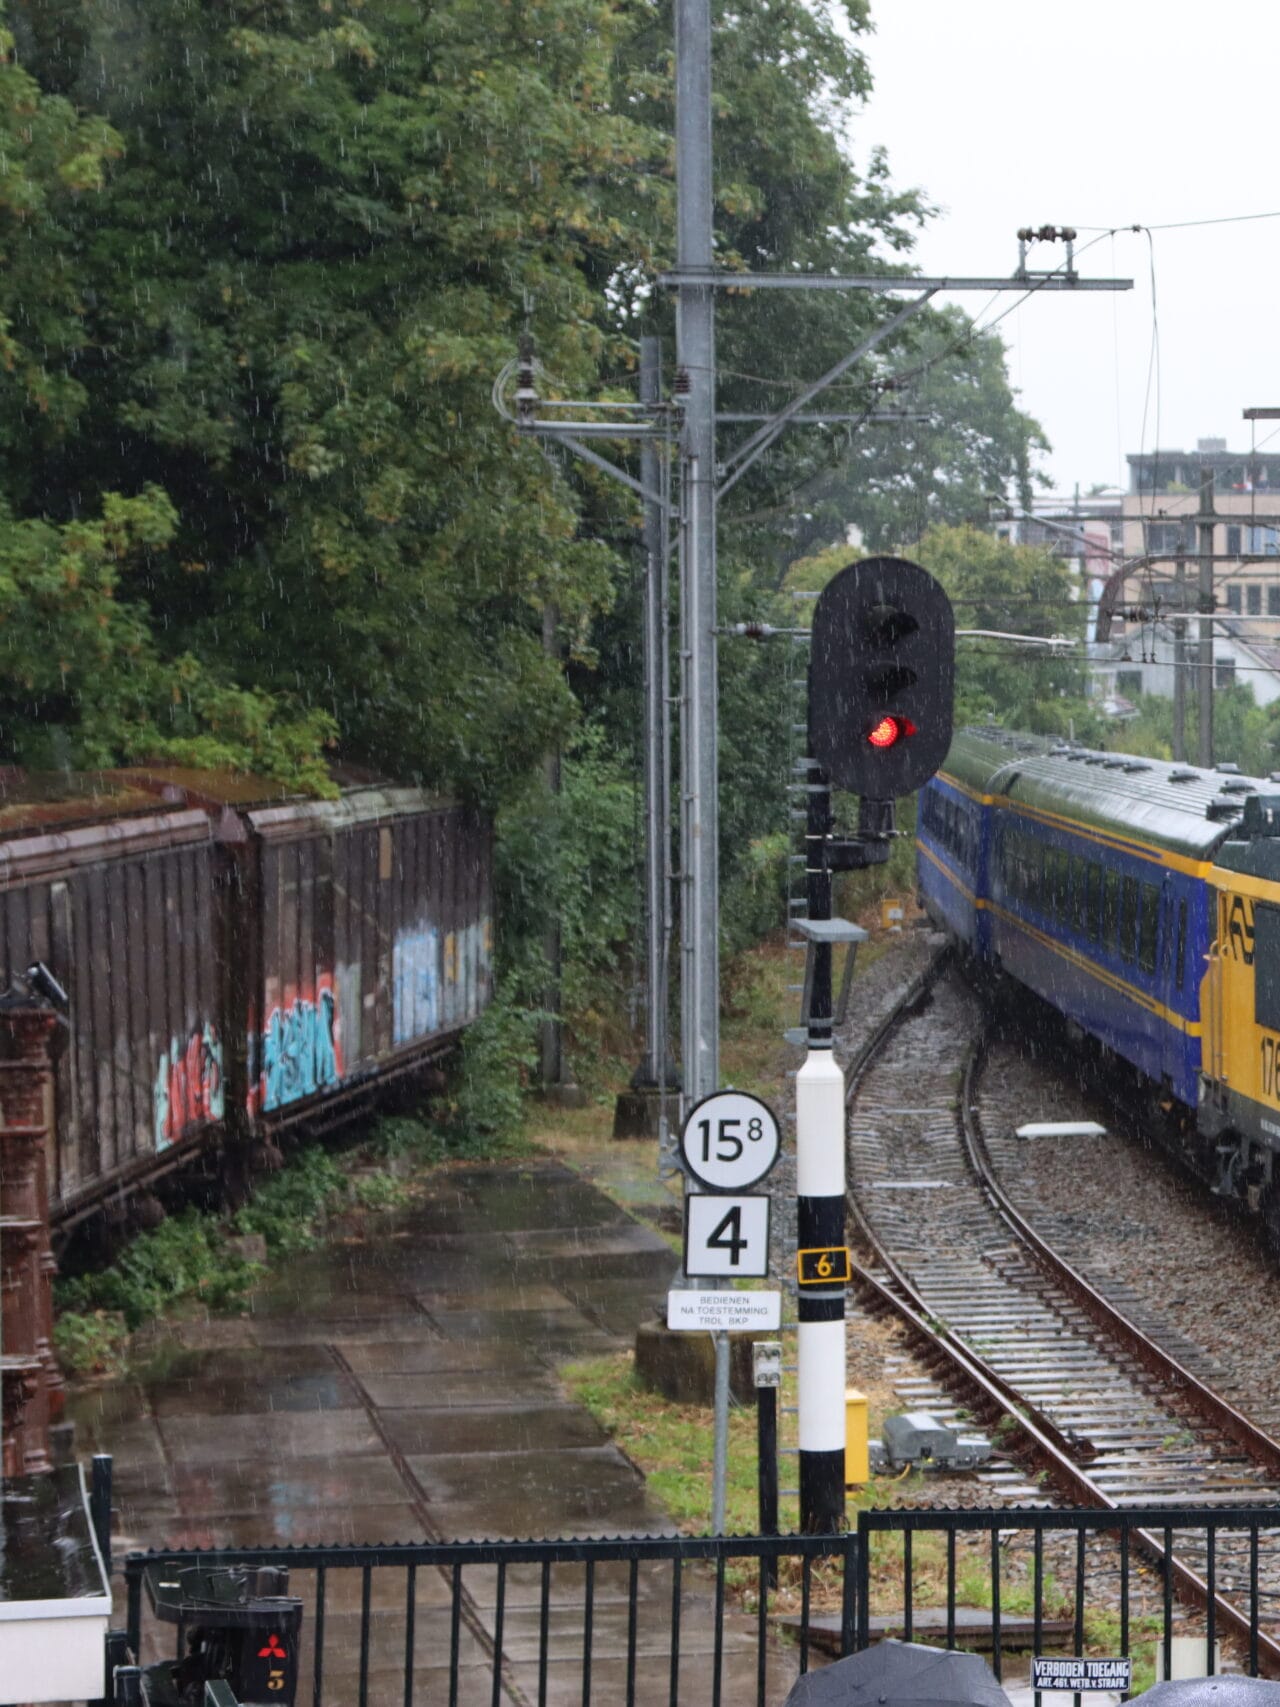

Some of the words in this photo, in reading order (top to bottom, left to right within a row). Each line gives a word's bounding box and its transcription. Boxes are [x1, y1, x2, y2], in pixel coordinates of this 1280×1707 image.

[706, 1206, 748, 1266] 4
[817, 1254, 832, 1277] 6
[700, 1296, 750, 1304] BEDIENEN
[680, 1306, 694, 1314] NA
[697, 1306, 768, 1315] TOESTEMMING
[1034, 1661, 1085, 1677] VERBODEN
[1087, 1662, 1129, 1677] TOEGANG
[267, 1670, 285, 1690] 5
[1036, 1677, 1053, 1687] ART.
